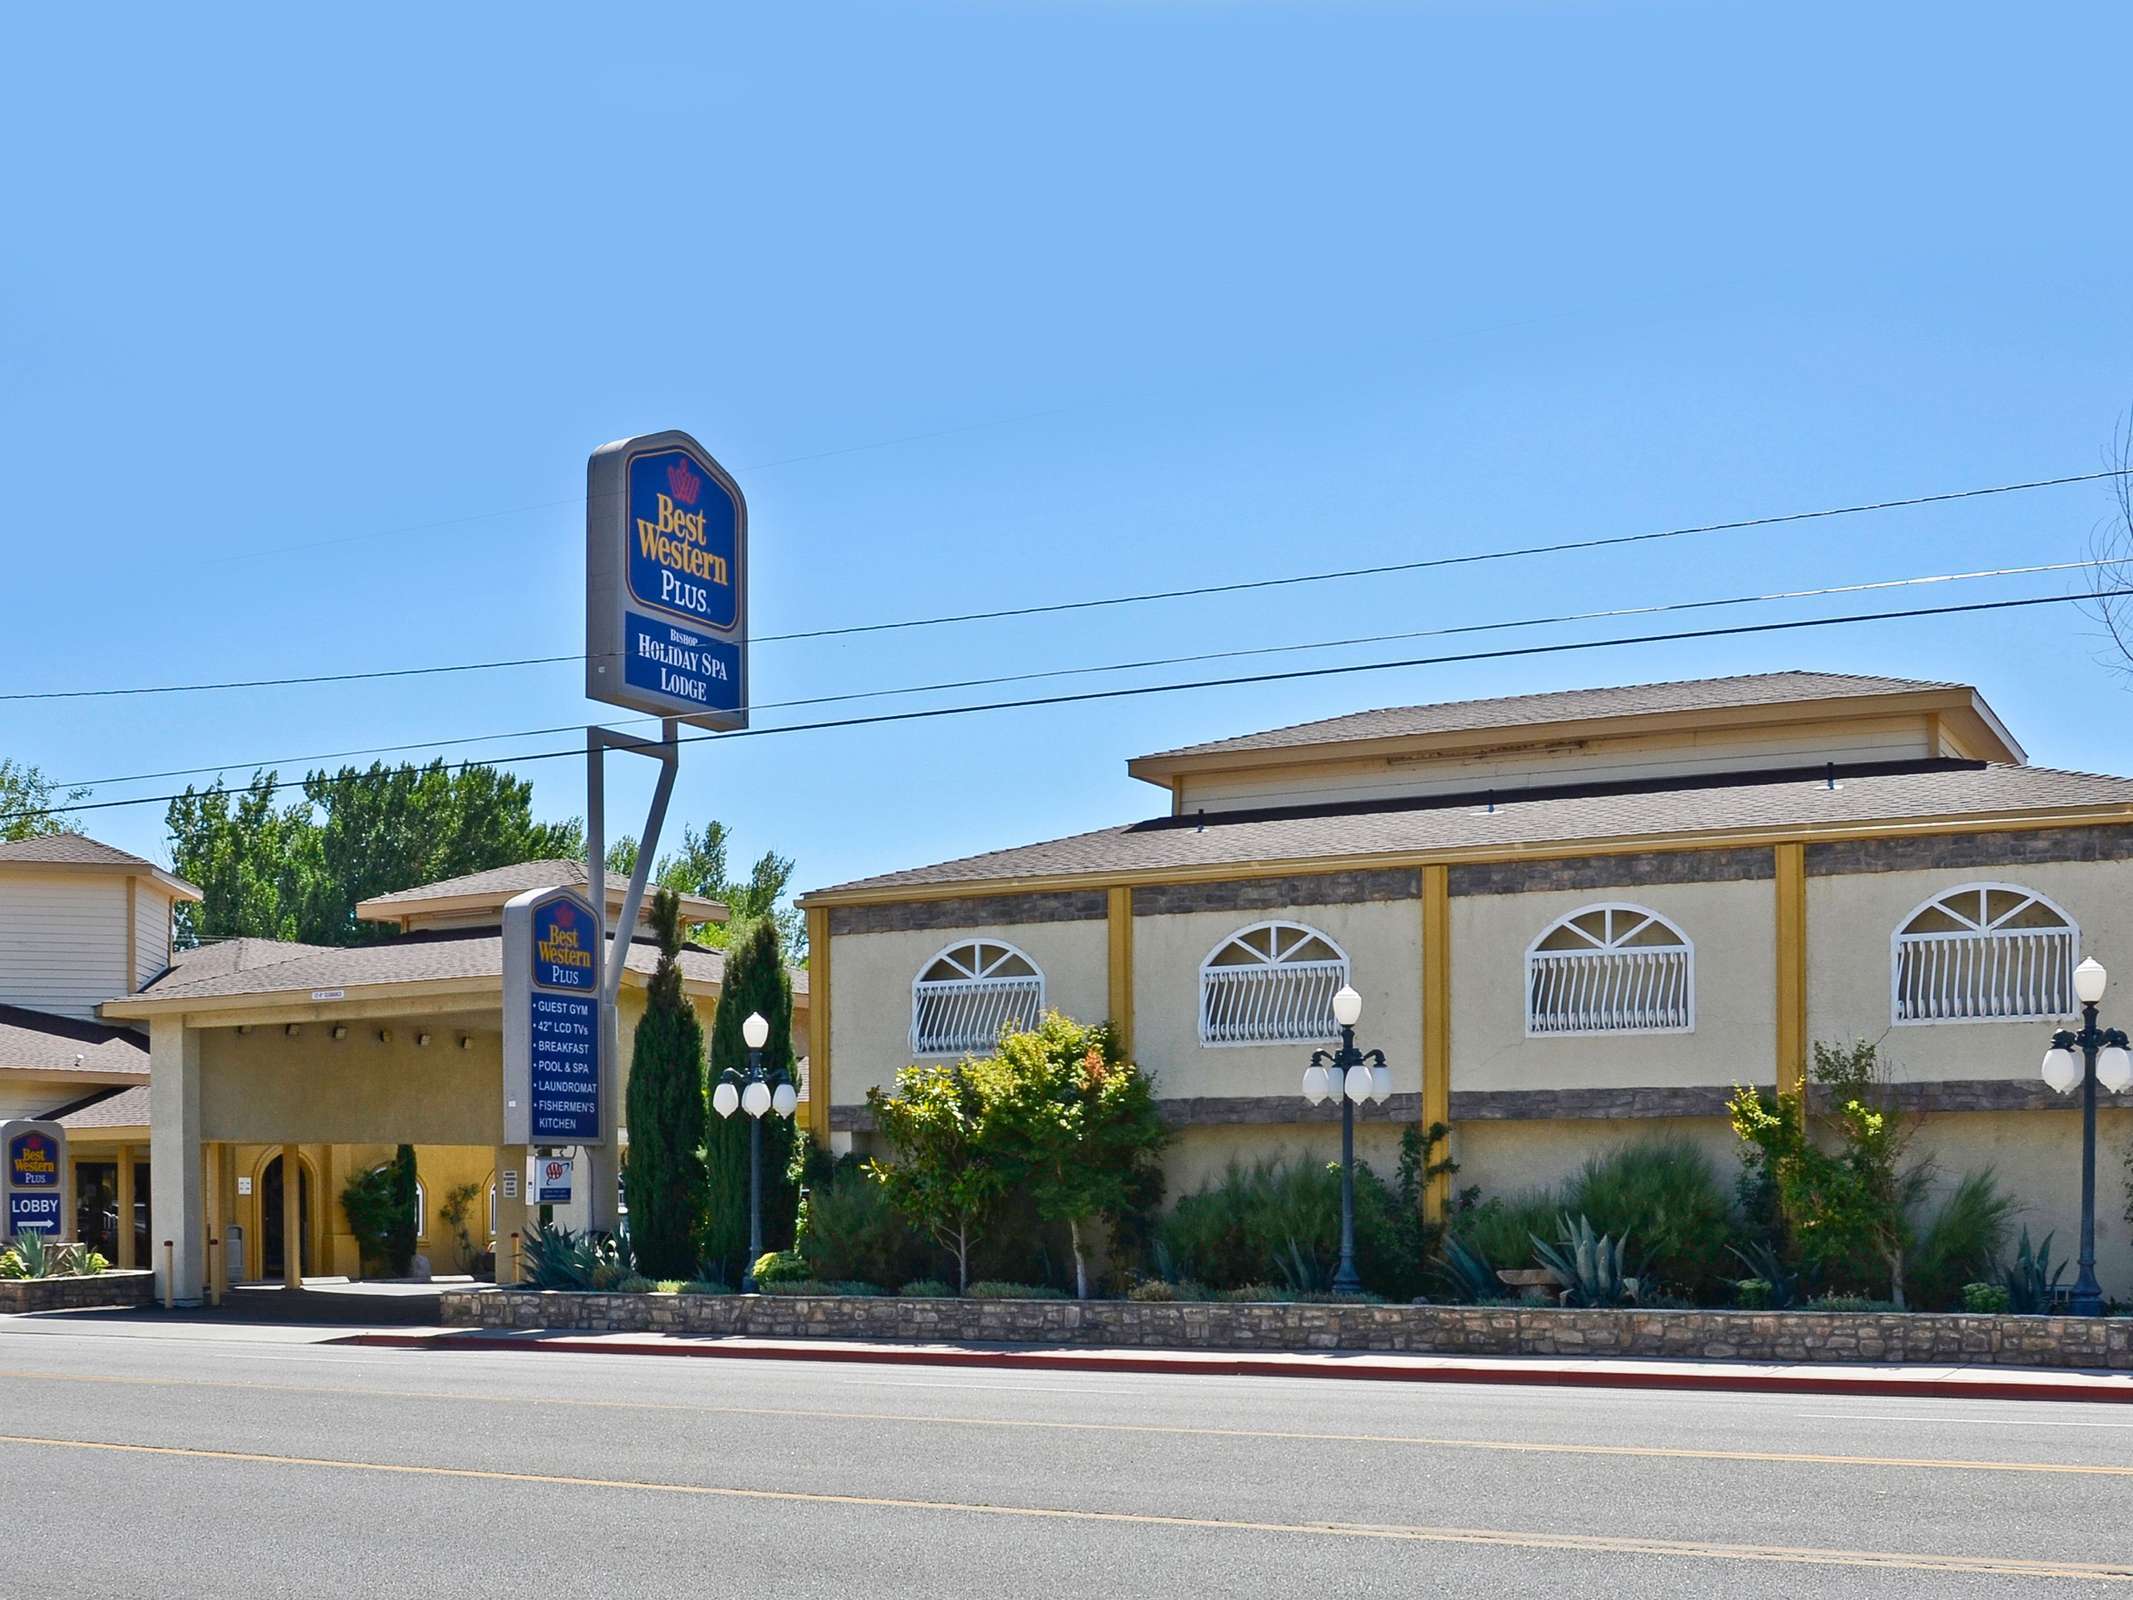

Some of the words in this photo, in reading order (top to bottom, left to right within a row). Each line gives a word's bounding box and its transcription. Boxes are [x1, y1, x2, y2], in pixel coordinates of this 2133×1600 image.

[657, 493, 706, 546] Best
[637, 518, 728, 586] Western
[661, 569, 707, 612] PLUS
[670, 628, 698, 646] BISHOP
[638, 633, 699, 672] HOLIDAY
[701, 652, 728, 681] SPA
[661, 667, 707, 701] LODGE
[549, 924, 578, 948] Best
[538, 940, 591, 968] Western
[552, 965, 579, 985] PLUS
[538, 1000, 567, 1014] GUEST
[569, 1004, 588, 1016] GYM
[554, 1022, 572, 1034] LCD
[573, 1023, 589, 1036] TVs
[538, 1040, 590, 1055] BREAKFAST
[538, 1060, 563, 1073] POOL
[564, 1062, 571, 1073] &
[572, 1063, 590, 1075] SPA
[538, 1081, 598, 1094] LAUNDROMAT
[538, 1100, 596, 1113] FISHERMEN'S
[539, 1118, 577, 1130] KITCHEN
[23, 1148, 45, 1161] Best
[15, 1159, 54, 1172] Western
[25, 1172, 46, 1184] PLUS
[12, 1199, 58, 1213] LOBBY
